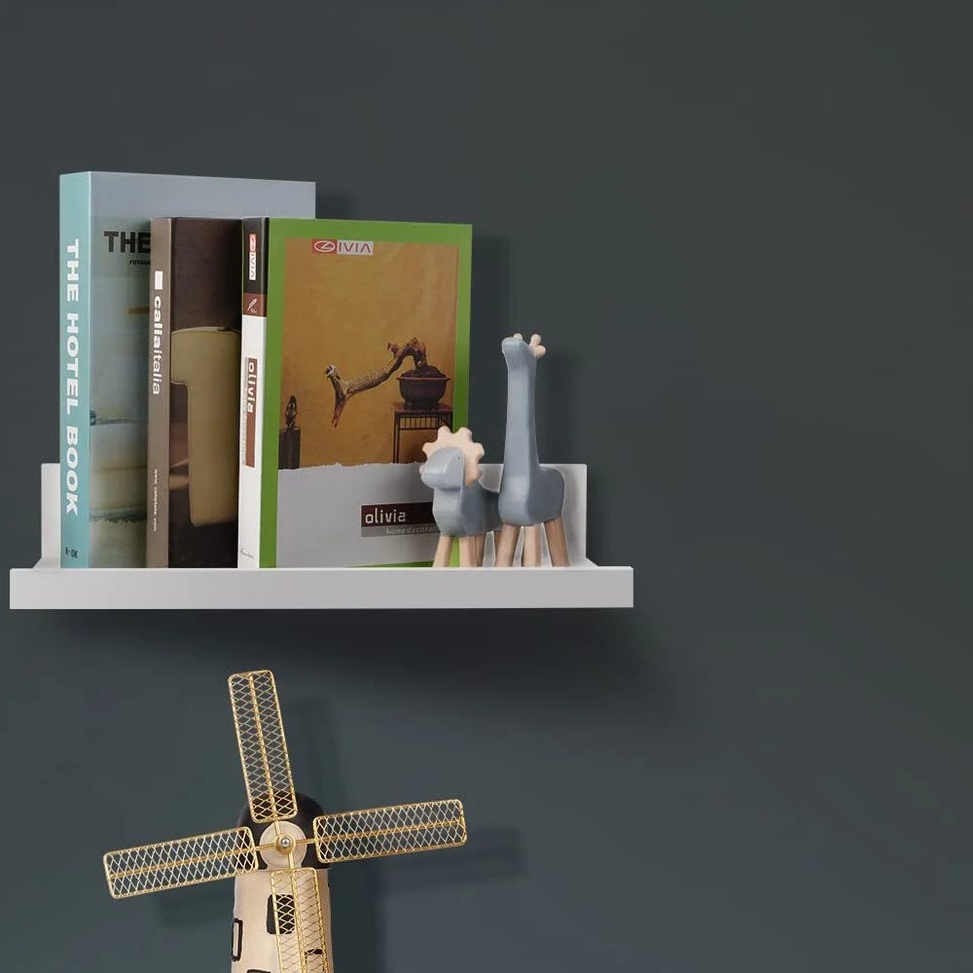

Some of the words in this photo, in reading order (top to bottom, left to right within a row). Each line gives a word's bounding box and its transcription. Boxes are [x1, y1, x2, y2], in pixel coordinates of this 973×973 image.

[67, 239, 79, 302] THE
[104, 231, 151, 253] THE
[67, 313, 79, 415] HOTEL
[247, 362, 257, 413] olivia
[66, 426, 79, 516] BOOK
[365, 508, 406, 524] olivia
